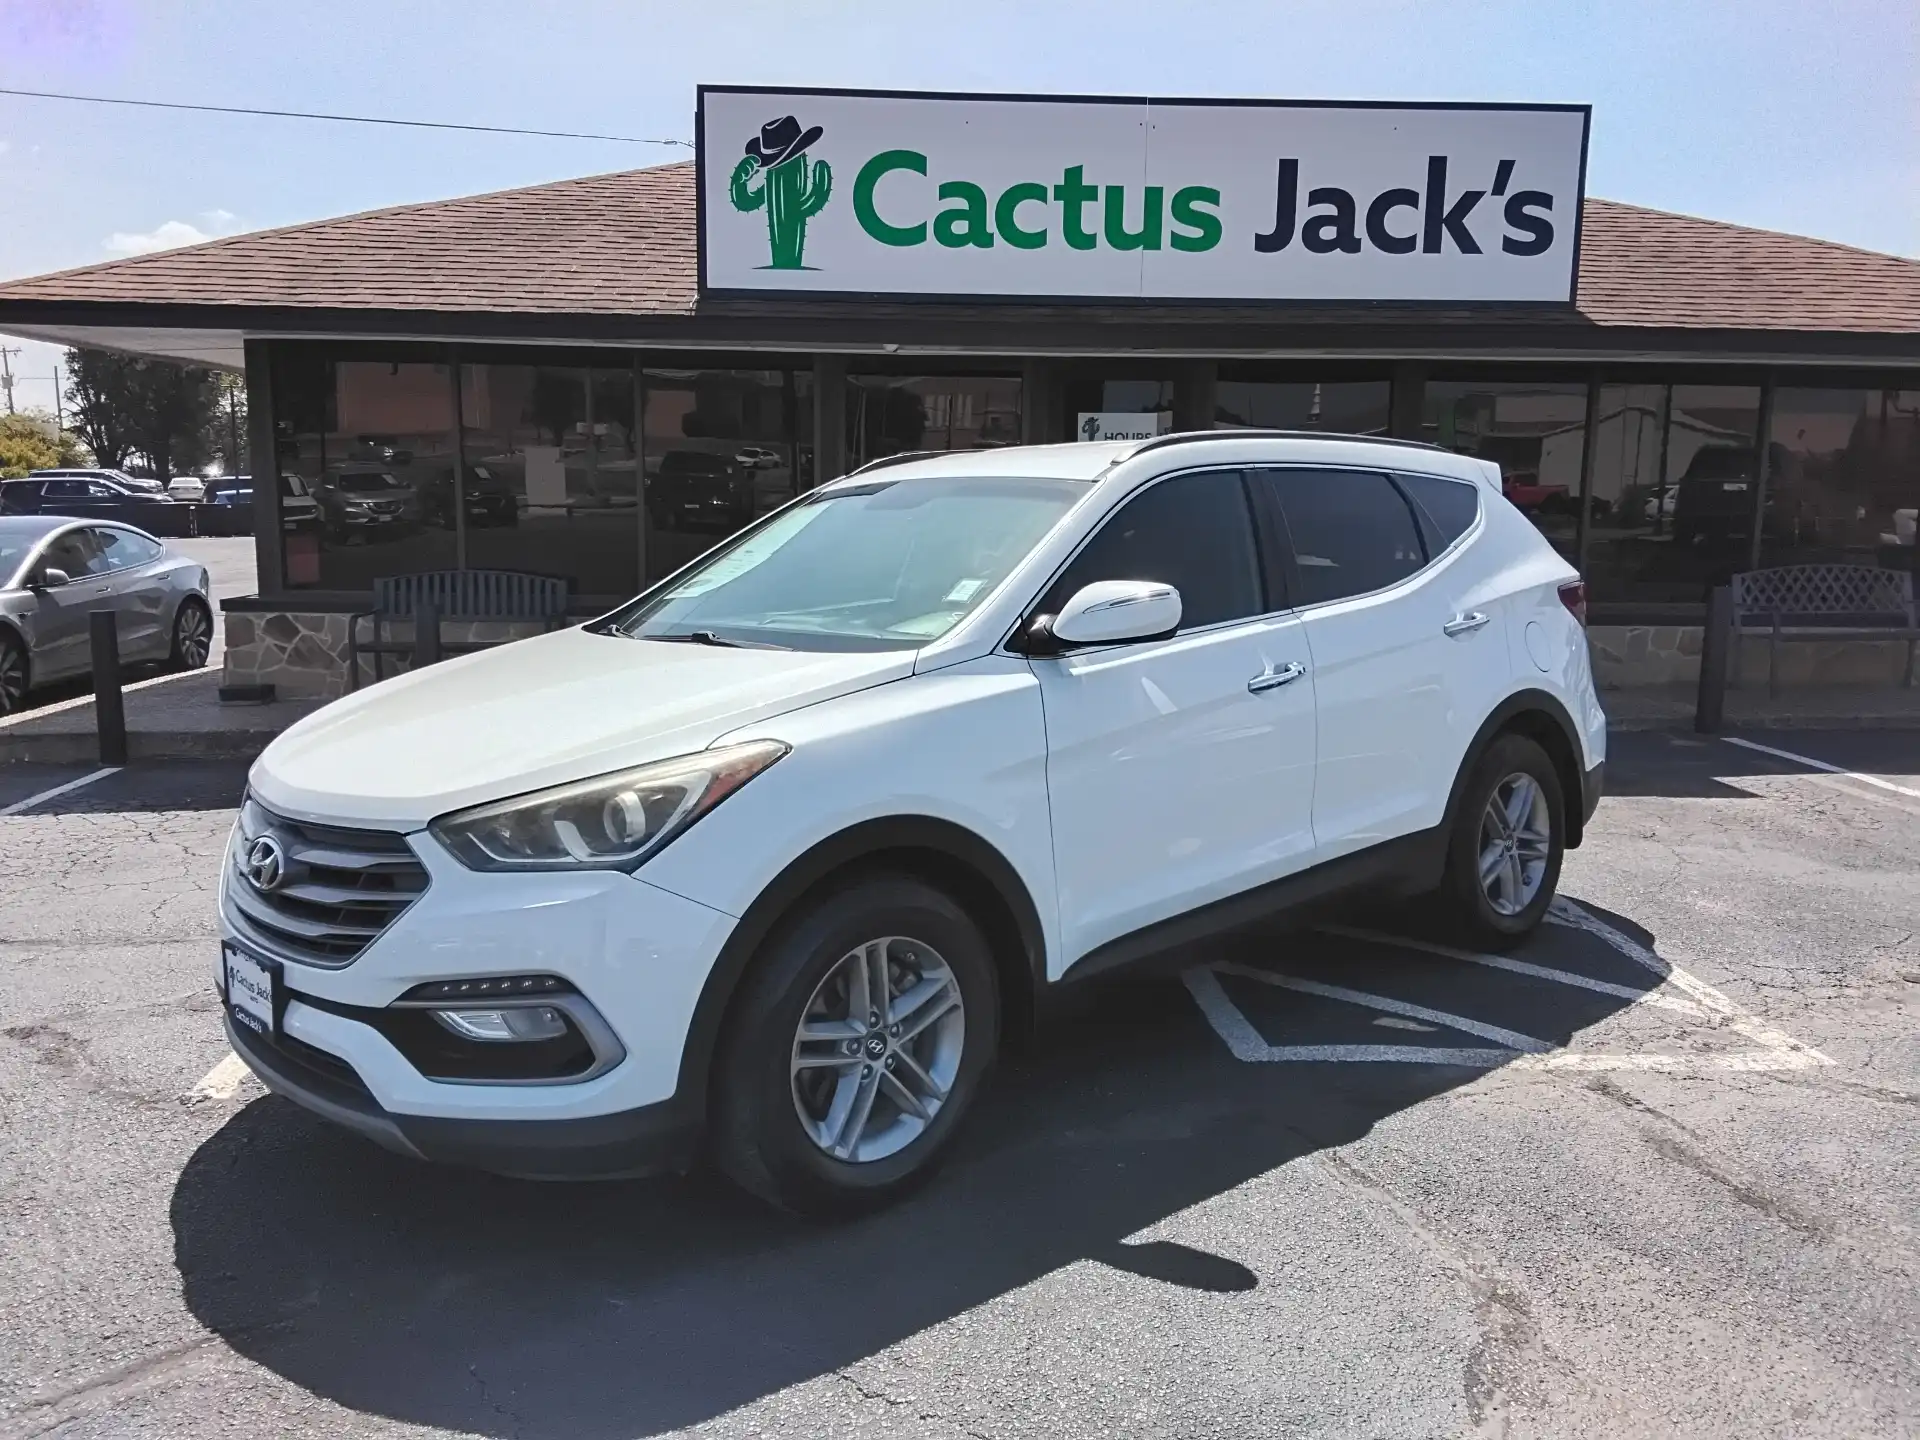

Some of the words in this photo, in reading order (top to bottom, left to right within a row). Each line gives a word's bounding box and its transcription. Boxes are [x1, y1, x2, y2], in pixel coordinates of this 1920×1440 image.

[852, 149, 1223, 253] Cactus
[1253, 155, 1555, 257] Jack's
[235, 969, 255, 994] Cactus
[235, 1007, 250, 1026] Cactus
